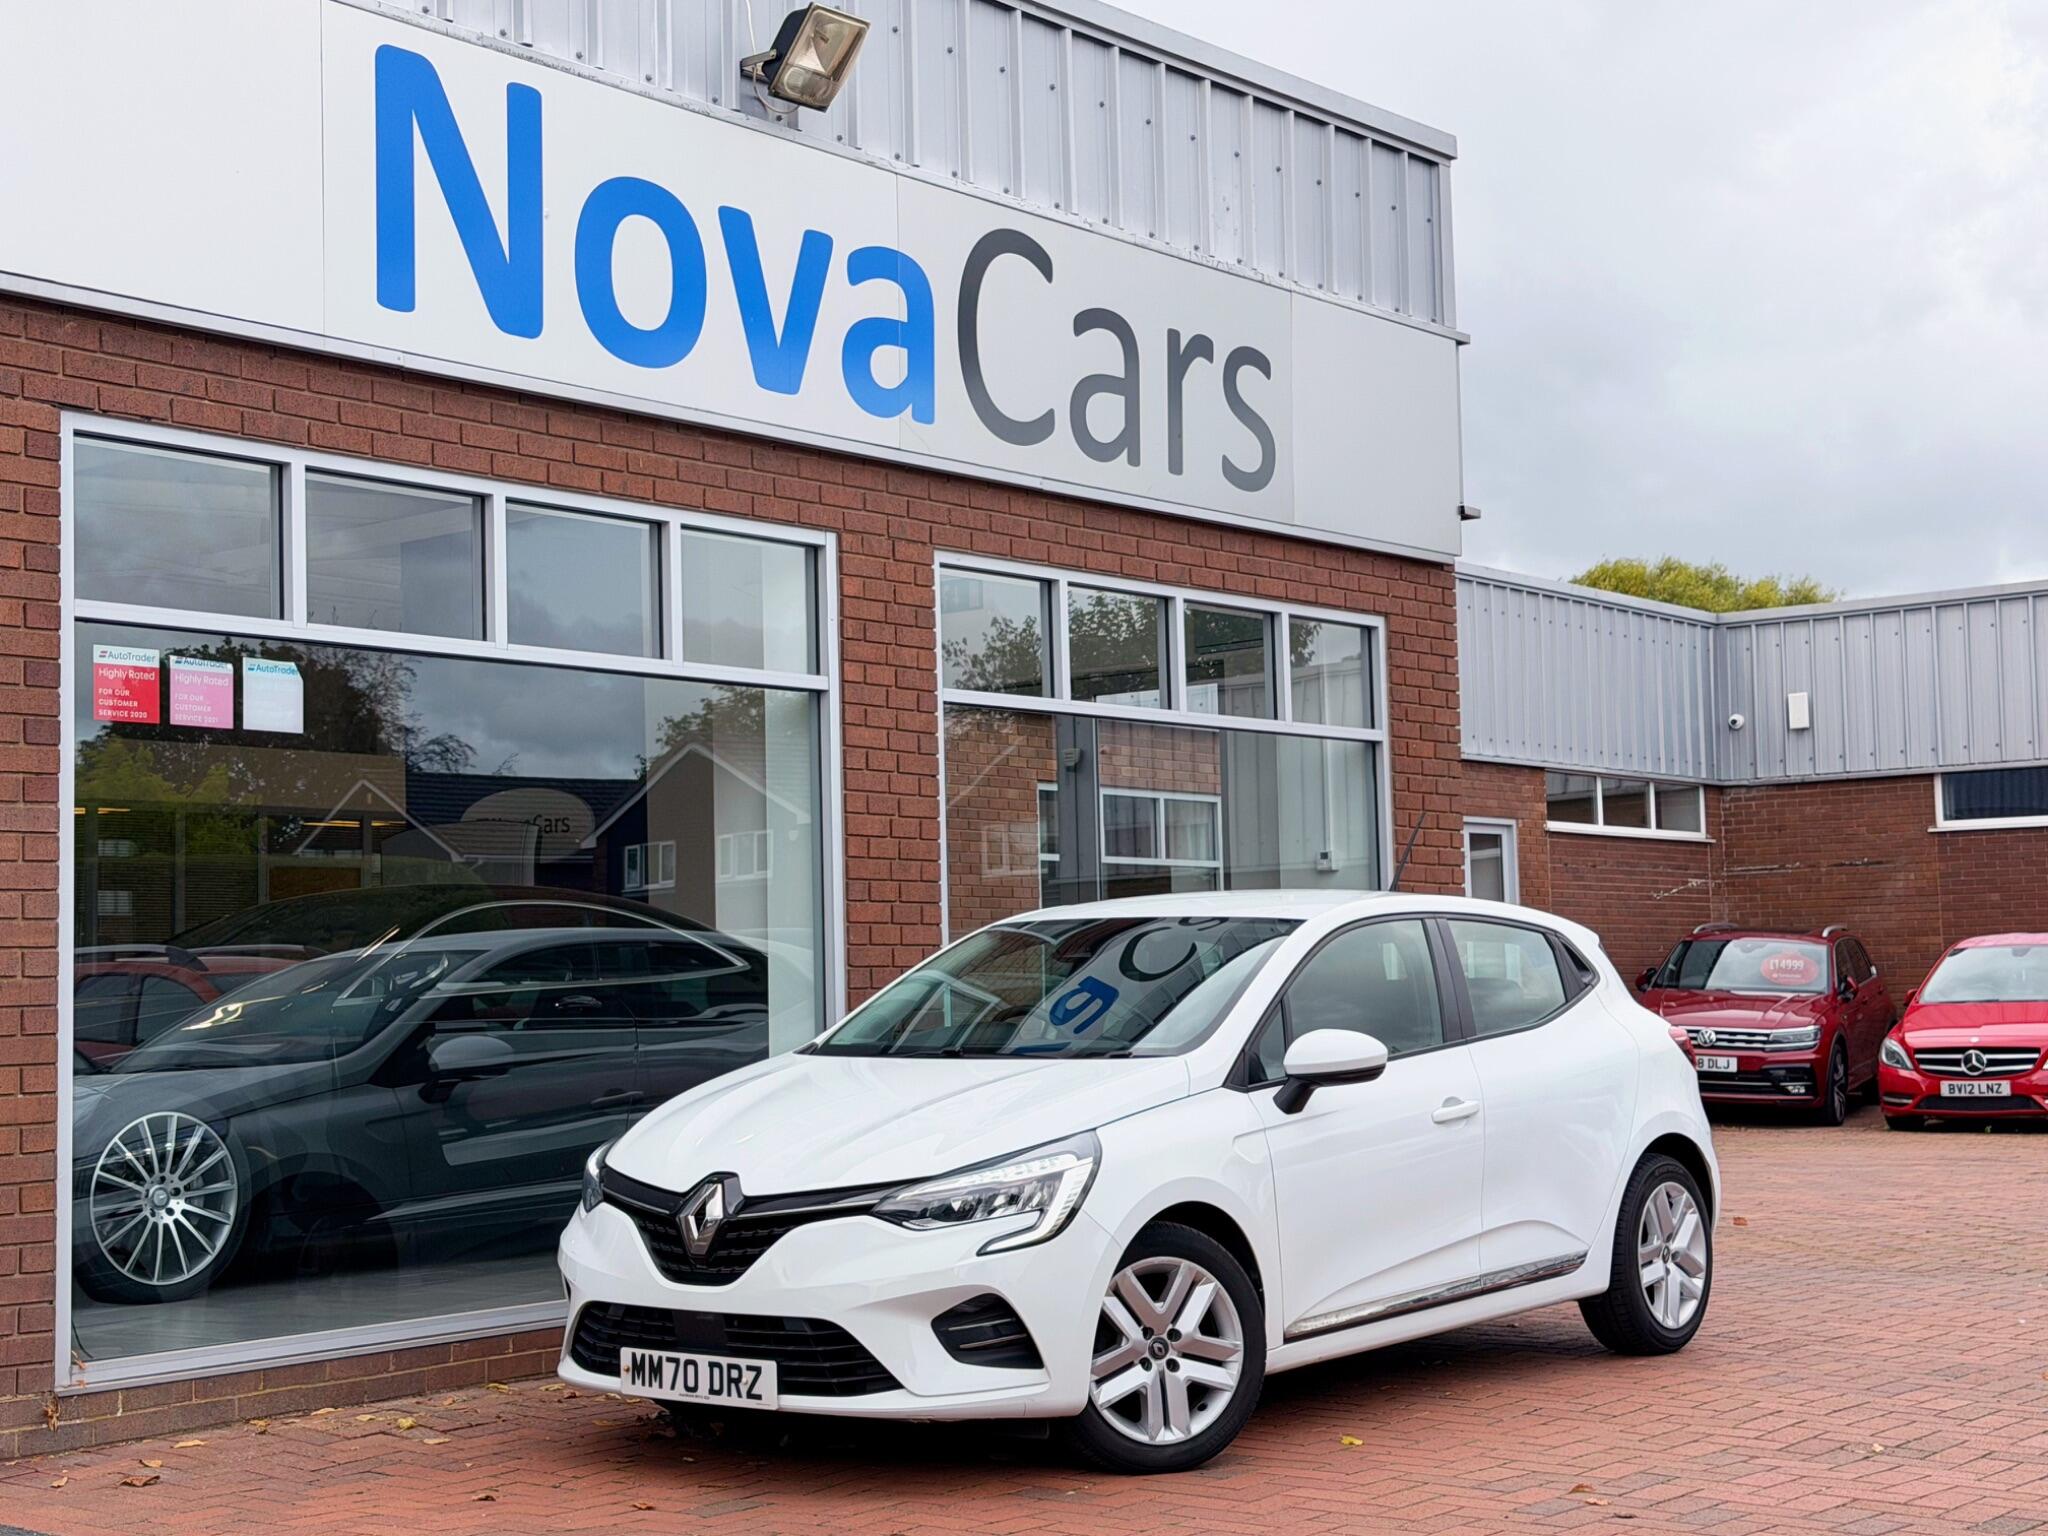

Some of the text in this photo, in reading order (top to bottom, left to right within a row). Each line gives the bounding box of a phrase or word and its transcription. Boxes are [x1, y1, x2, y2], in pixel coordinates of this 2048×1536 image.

[108, 651, 155, 663] AutoTrader
[99, 668, 155, 681] Highly Rated
[175, 674, 229, 687] Highly Rated
[99, 688, 130, 697] FOR OUR
[175, 693, 189, 701] FOR
[99, 698, 138, 708] CUSTOMER
[175, 703, 212, 712] CUSTOMER
[99, 709, 148, 719] SERVICE 2020
[175, 713, 202, 723] SERVICE
[1707, 1058, 1731, 1070] DLJ
[1948, 1083, 2002, 1095] BV12 LNZ
[631, 1351, 763, 1401] MM70 DRZ
